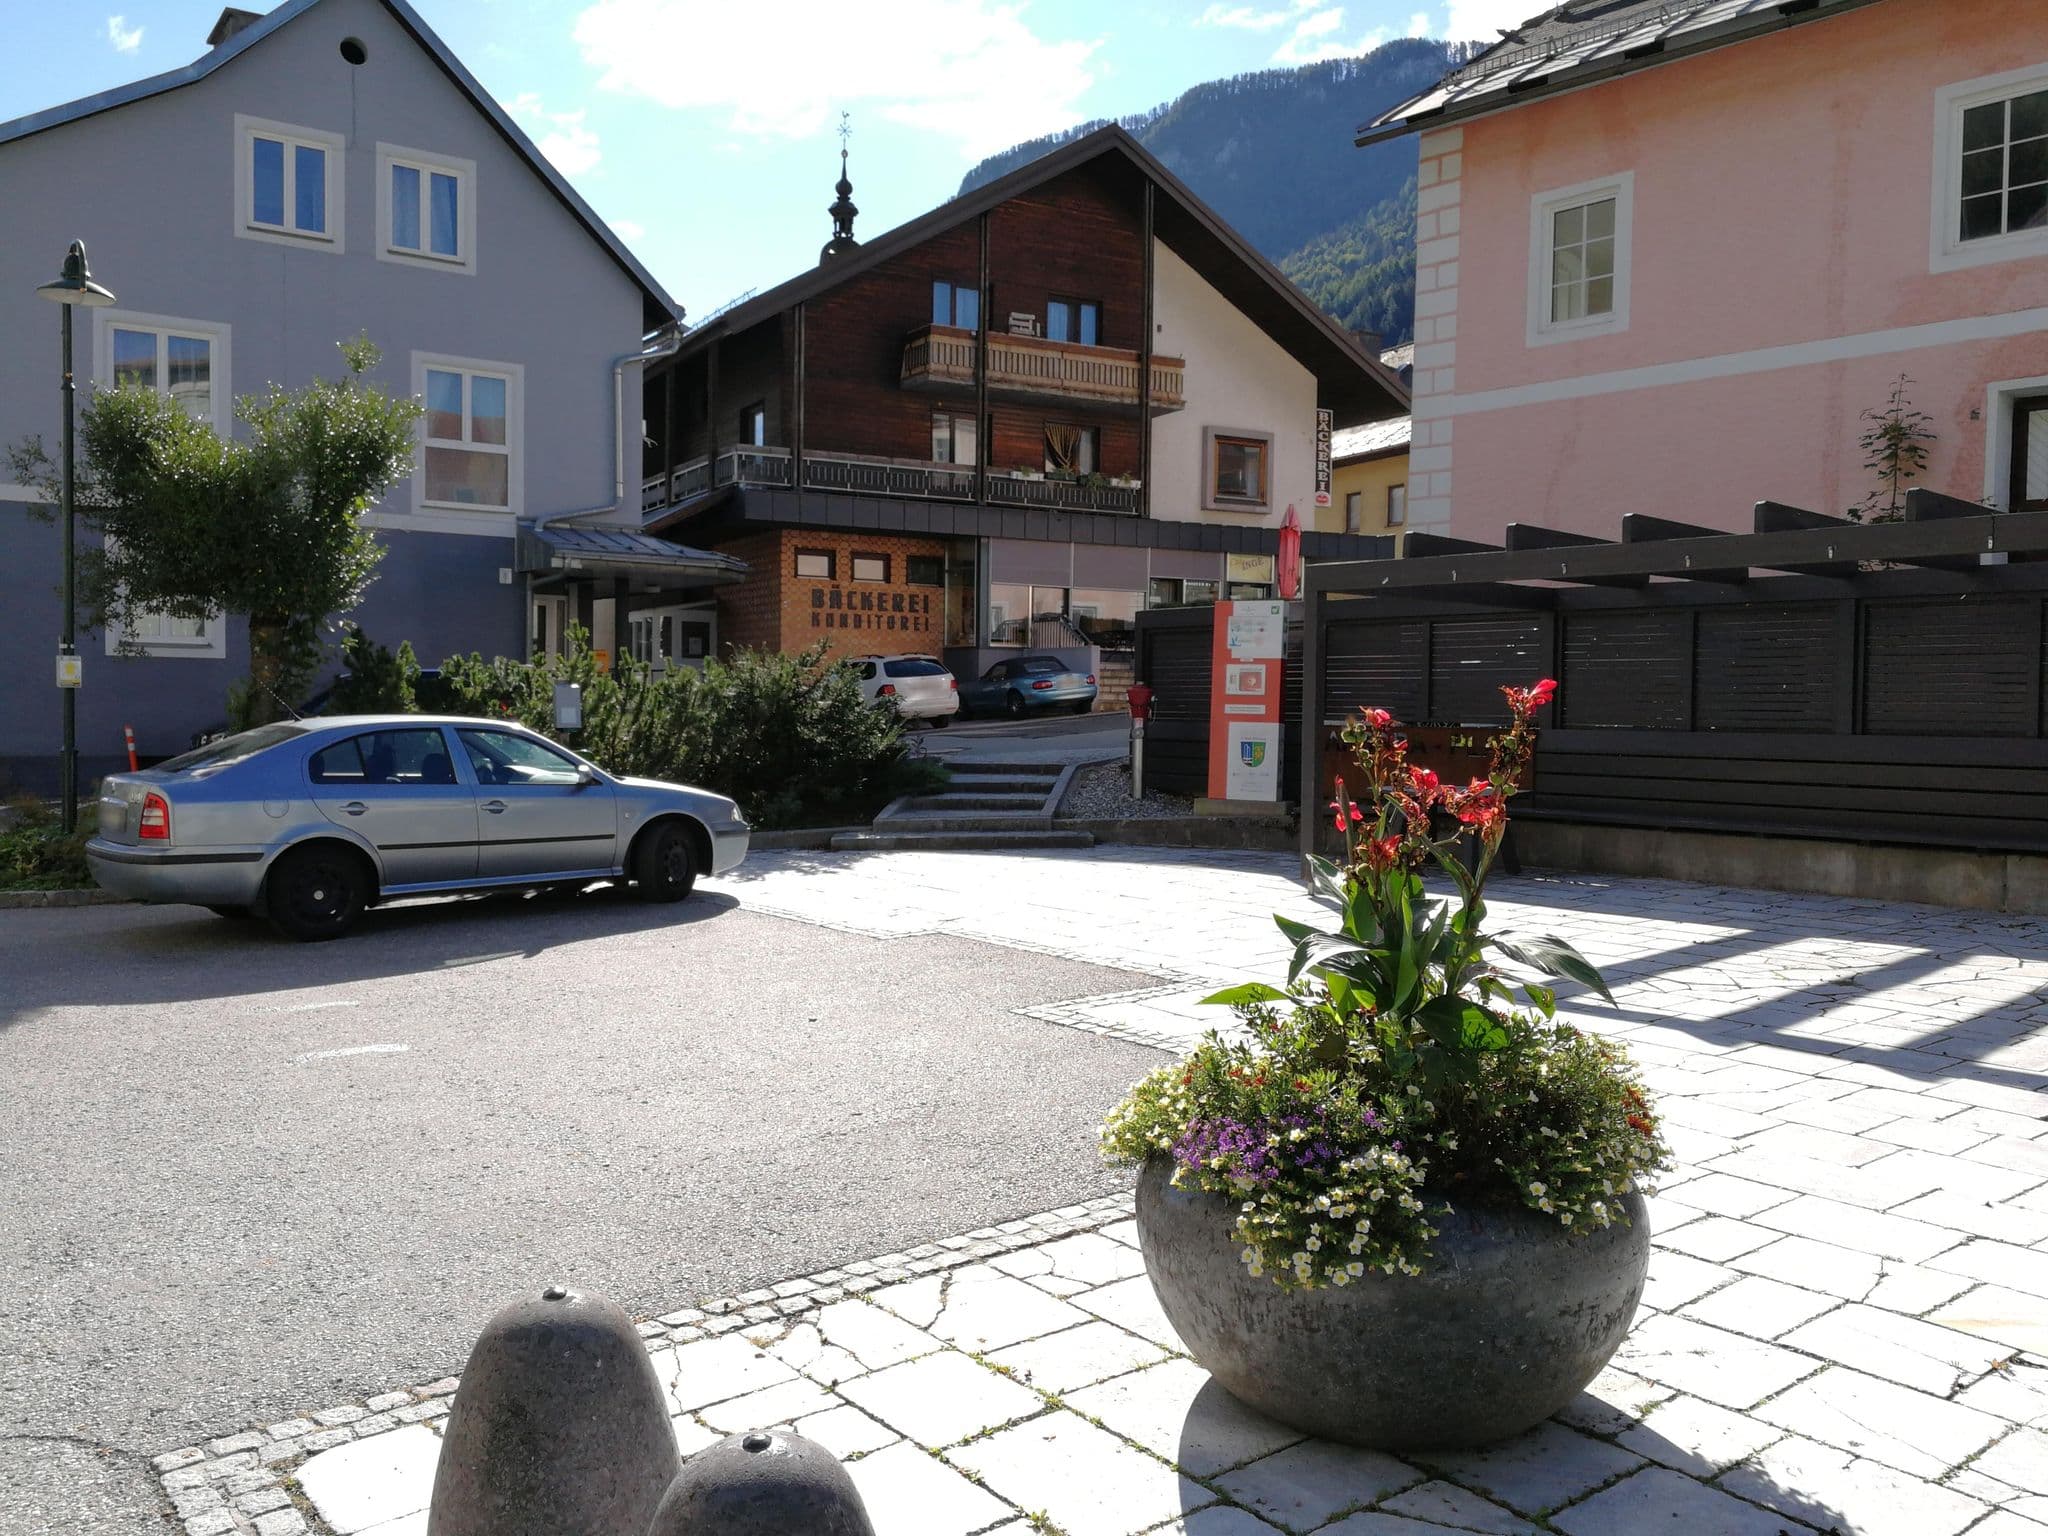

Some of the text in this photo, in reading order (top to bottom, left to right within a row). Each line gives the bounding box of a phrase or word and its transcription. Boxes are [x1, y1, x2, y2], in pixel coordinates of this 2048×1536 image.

[1317, 411, 1330, 491] BÄCKEREI
[811, 584, 930, 614] BÄCKEREI
[811, 612, 930, 632] KONDITOREI
